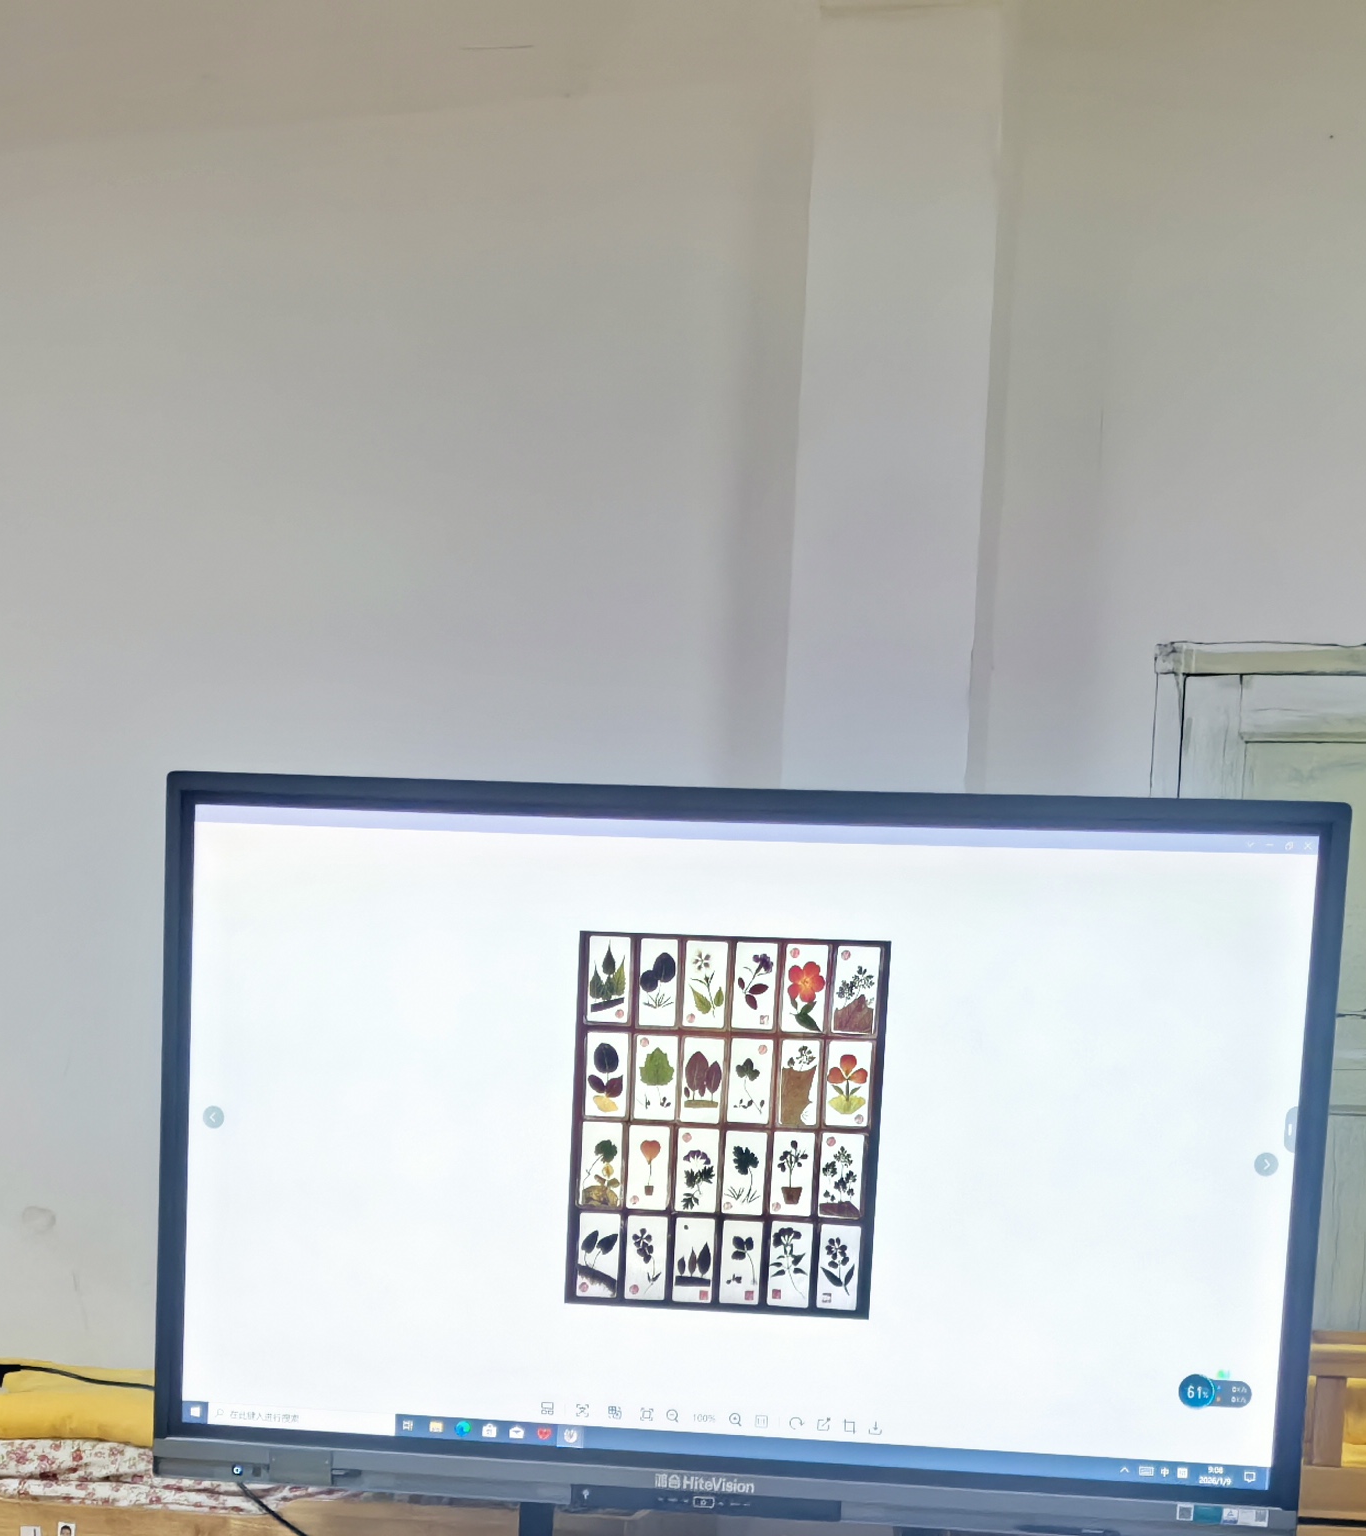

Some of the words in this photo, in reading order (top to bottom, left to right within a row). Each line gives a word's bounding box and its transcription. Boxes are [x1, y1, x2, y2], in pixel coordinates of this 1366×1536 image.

[1187, 1386, 1209, 1399] 61%
[230, 1410, 300, 1424] 在此键入进行搜索
[693, 1413, 715, 1423] 100%
[1161, 1467, 1170, 1477] 中
[682, 1475, 754, 1493] HiteVision
[1198, 1476, 1232, 1486] 2026/1/9
